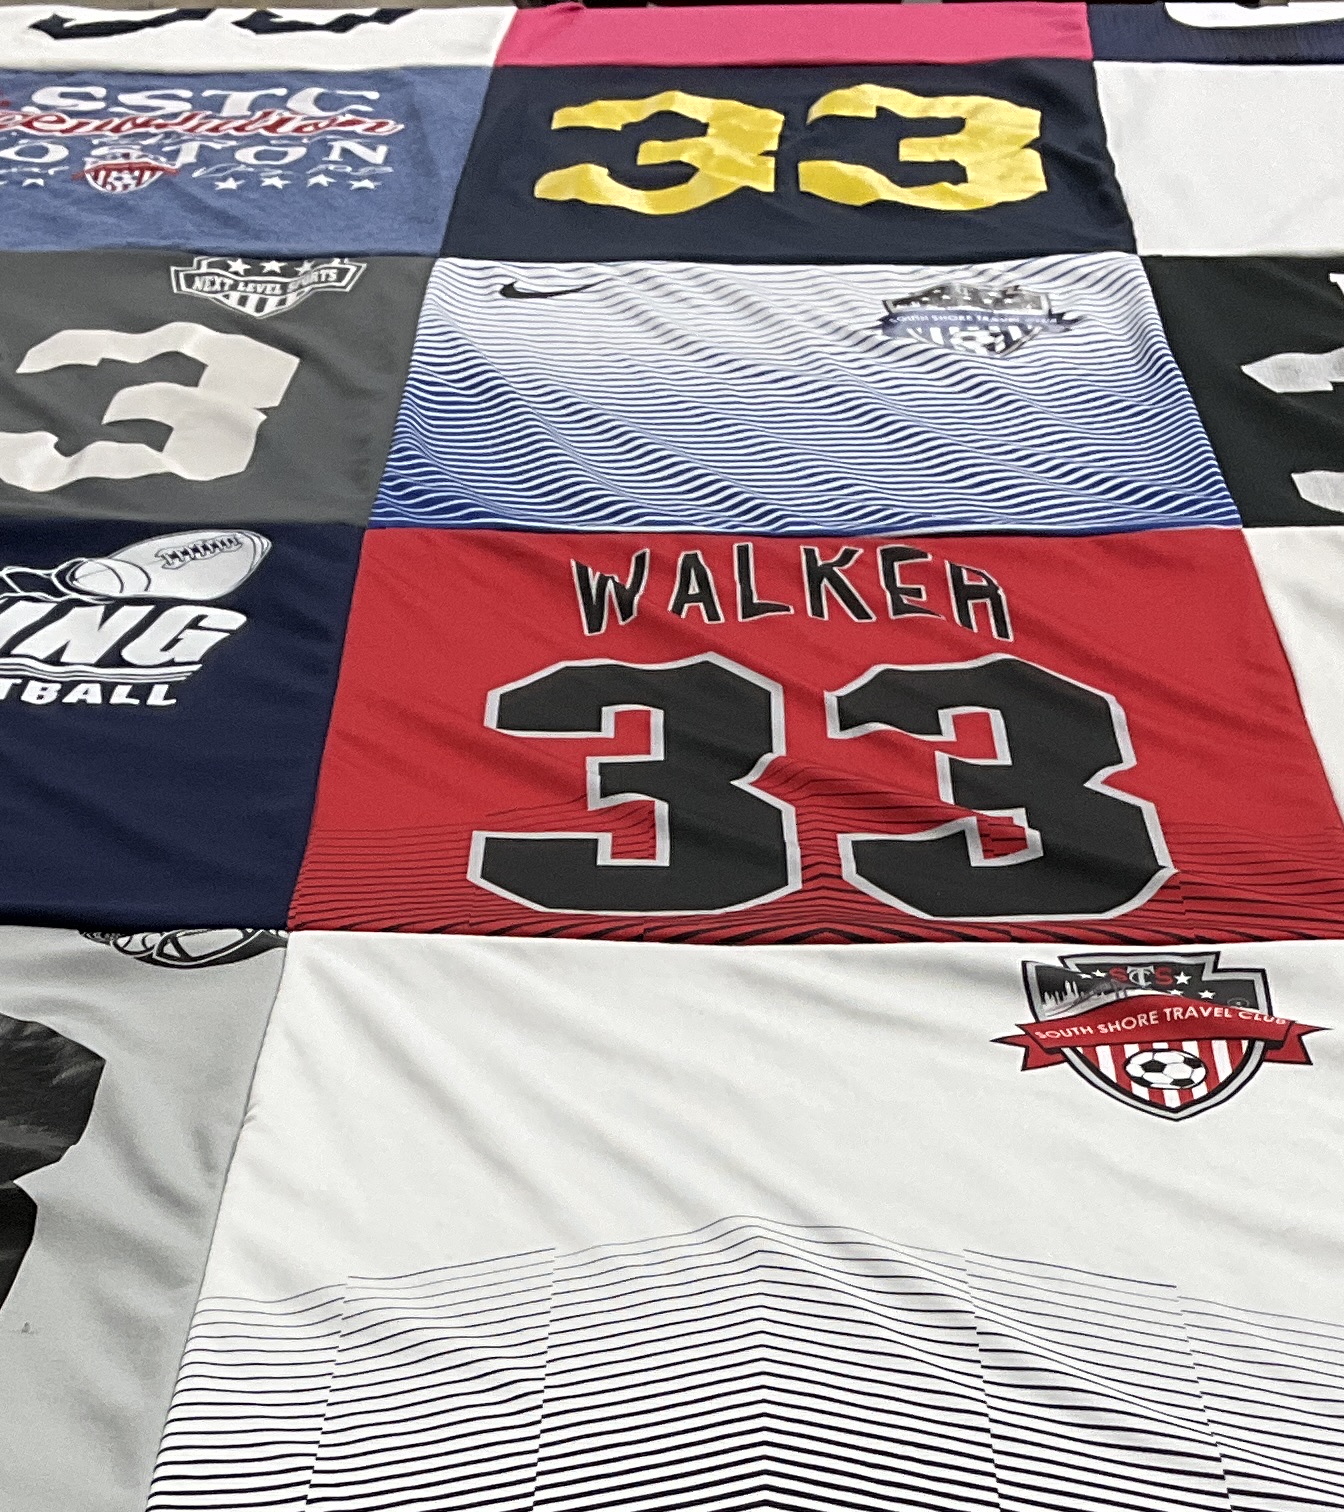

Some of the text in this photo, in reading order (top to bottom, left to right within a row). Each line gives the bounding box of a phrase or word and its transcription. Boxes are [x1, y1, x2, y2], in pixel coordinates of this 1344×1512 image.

[31, 86, 380, 118] SSTC
[534, 83, 1048, 215] 33
[192, 275, 234, 292] NEXT
[237, 281, 283, 295] LEVEL
[570, 542, 1015, 642] WALKER
[467, 651, 1180, 923] 33
[1034, 1005, 1288, 1041] SOUTH SHORE TRAVEL CLUB
